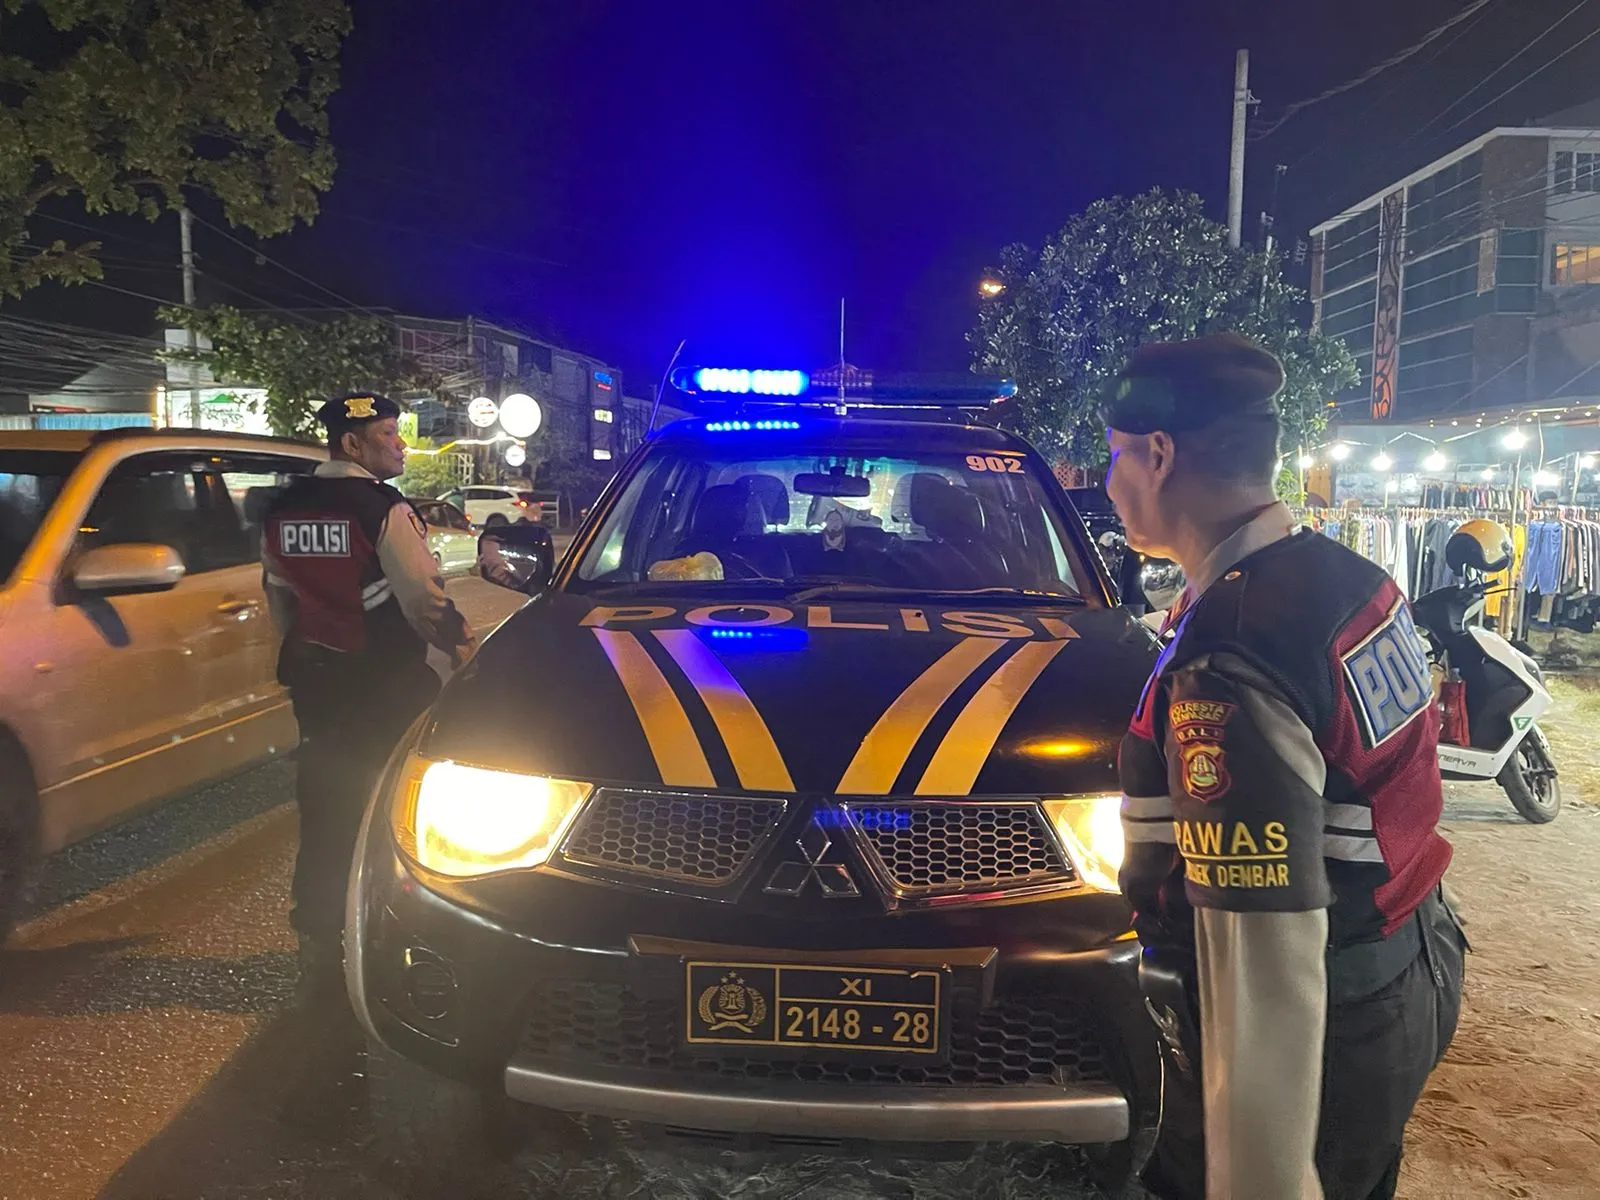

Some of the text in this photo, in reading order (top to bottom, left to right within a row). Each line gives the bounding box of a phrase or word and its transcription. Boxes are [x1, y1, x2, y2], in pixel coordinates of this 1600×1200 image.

[966, 455, 1025, 474] 902
[283, 524, 347, 553] POLISI
[578, 604, 1082, 640] POLISI
[1172, 821, 1288, 855] PAWAS
[1216, 863, 1290, 888] DENBAR
[839, 977, 872, 996] XI
[786, 1006, 861, 1039] 2148
[892, 1011, 930, 1043] 28
